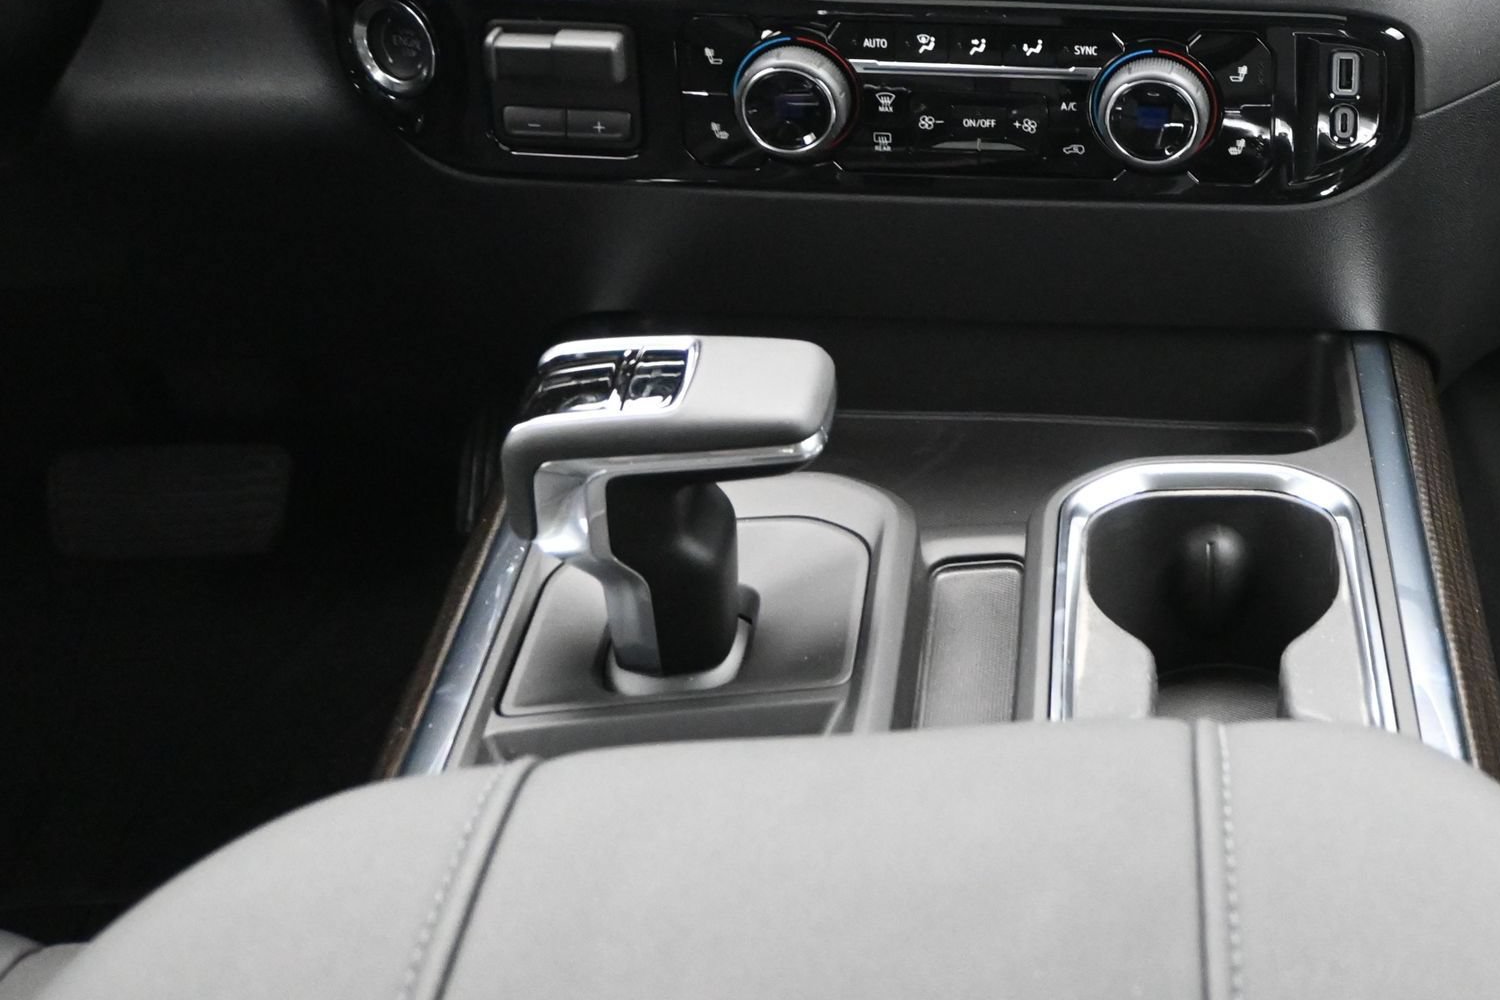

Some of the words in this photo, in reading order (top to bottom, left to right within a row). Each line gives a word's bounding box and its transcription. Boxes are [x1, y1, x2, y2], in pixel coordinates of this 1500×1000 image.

[862, 38, 888, 49] AUTO
[1073, 45, 1098, 56] SYNC
[878, 105, 893, 113] MAX
[1060, 101, 1078, 111] A/C
[962, 118, 996, 129] ON/OFF
